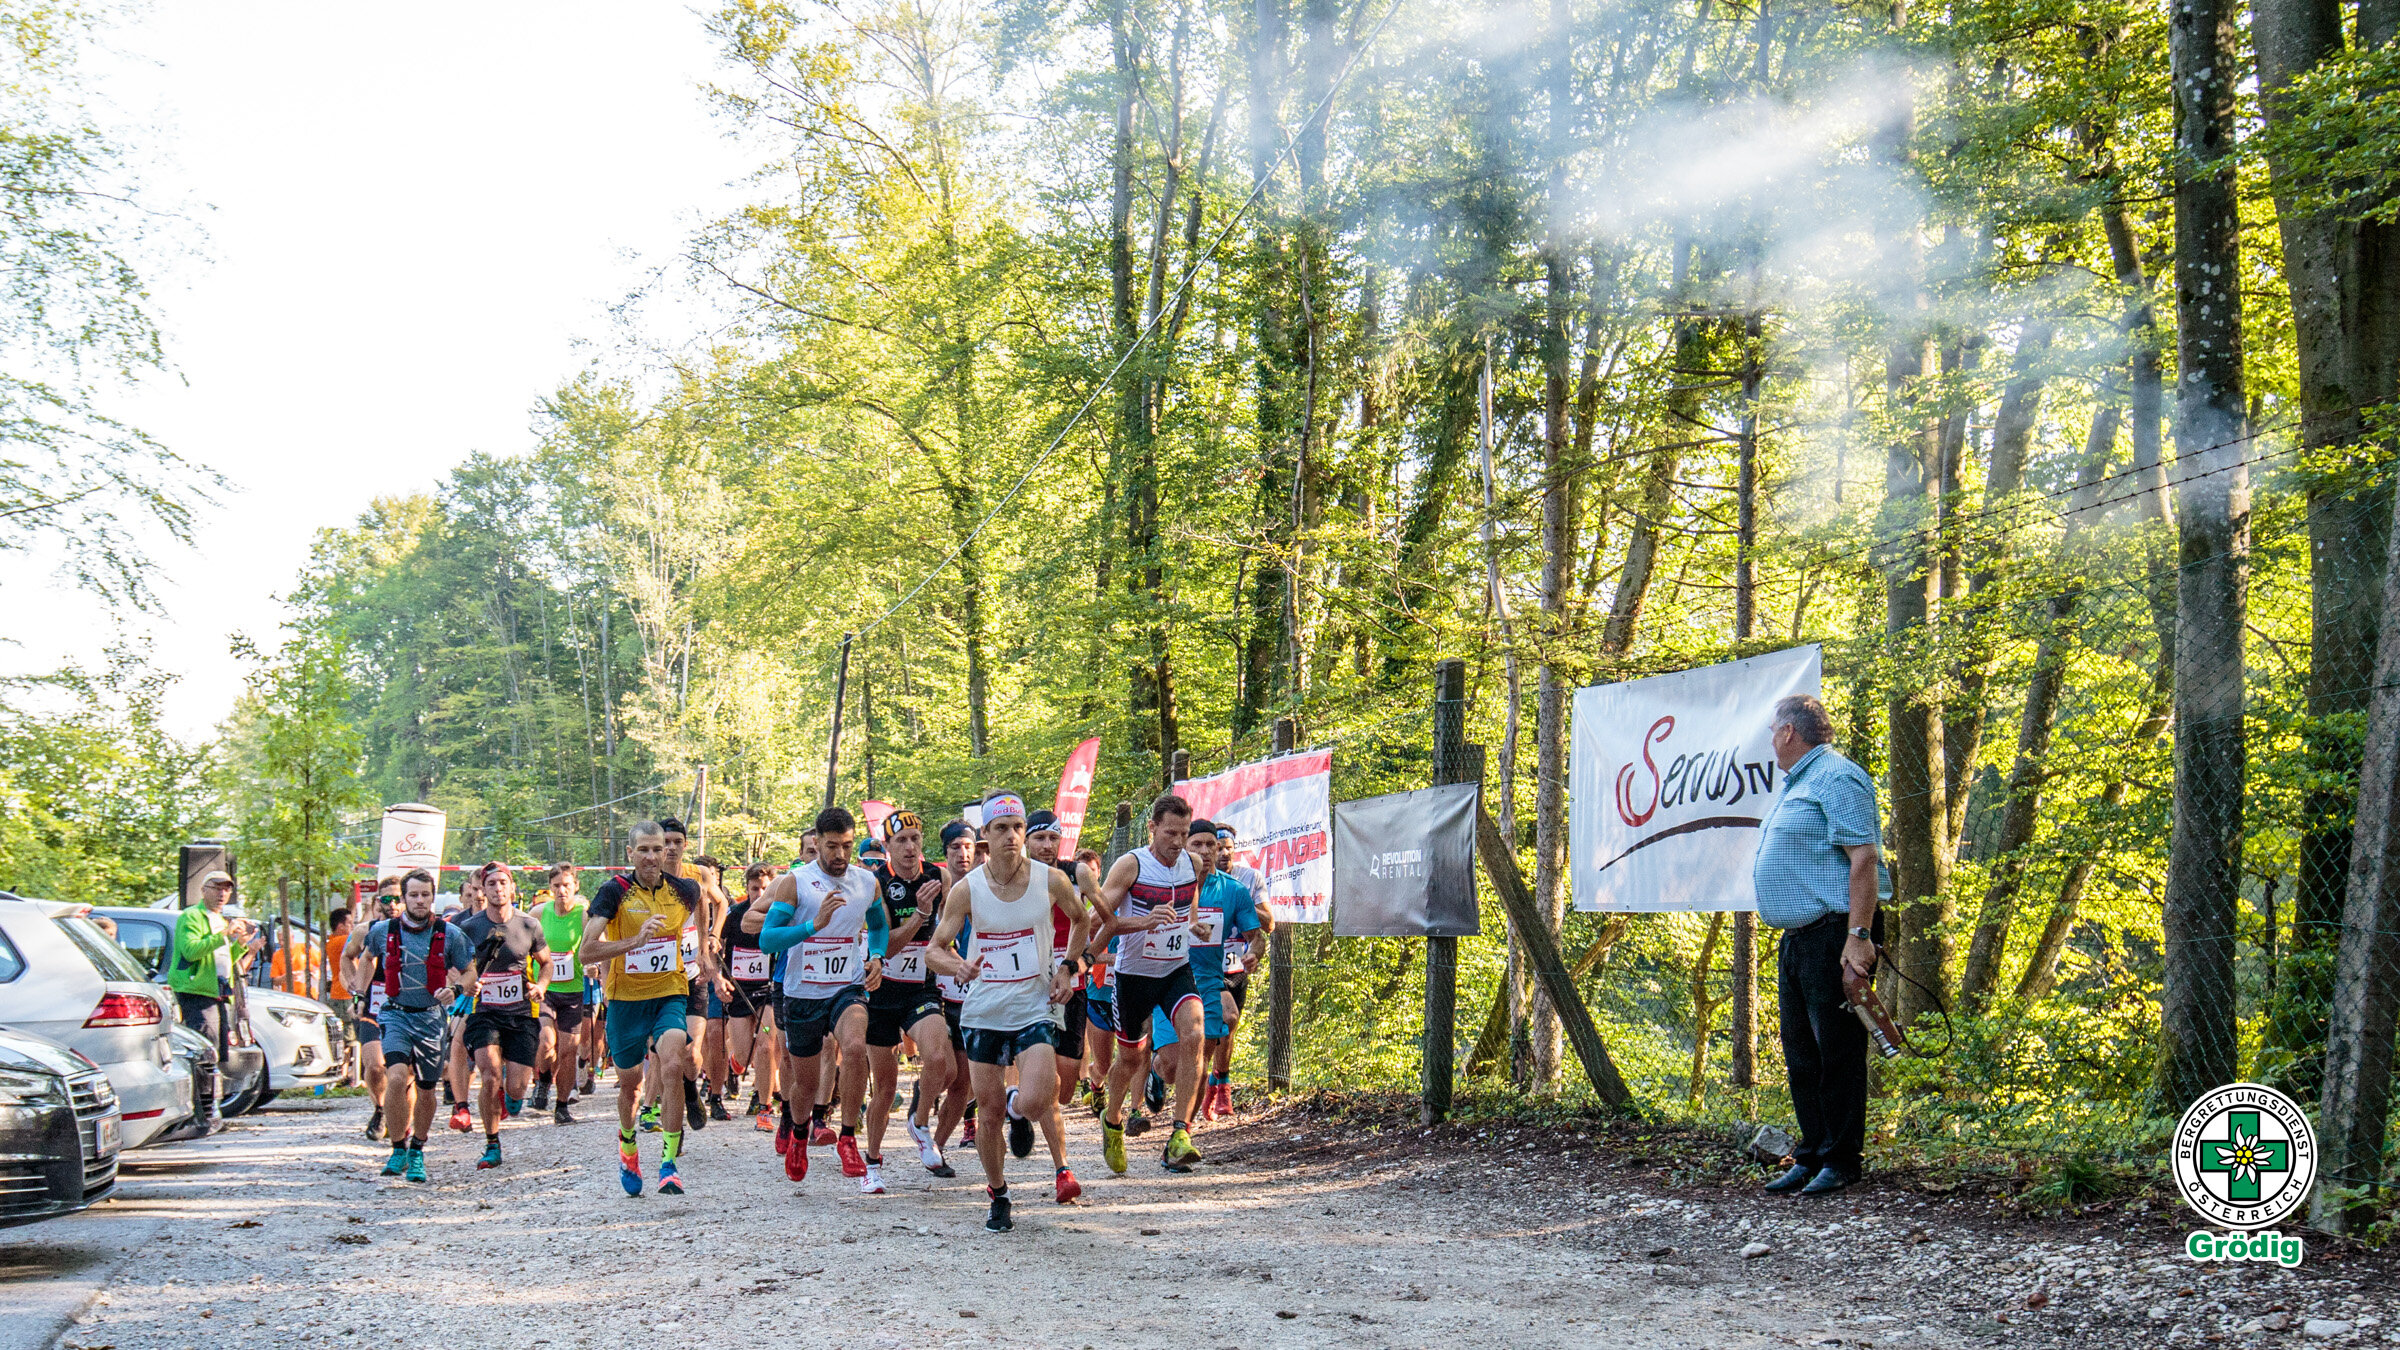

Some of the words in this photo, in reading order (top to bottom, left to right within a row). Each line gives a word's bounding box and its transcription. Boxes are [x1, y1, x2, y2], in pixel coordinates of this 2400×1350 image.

[992, 806, 1009, 816] Red
[1382, 849, 1422, 866] REVOLUTION
[1382, 863, 1422, 879] RENTAL
[1166, 934, 1182, 951] 48
[650, 954, 669, 972] 92
[824, 956, 849, 975] 107
[900, 956, 918, 973] 74
[1011, 952, 1020, 971] 1
[1225, 951, 1236, 966] 51
[556, 964, 566, 976] 11
[748, 961, 763, 974] 64
[497, 985, 518, 998] 169
